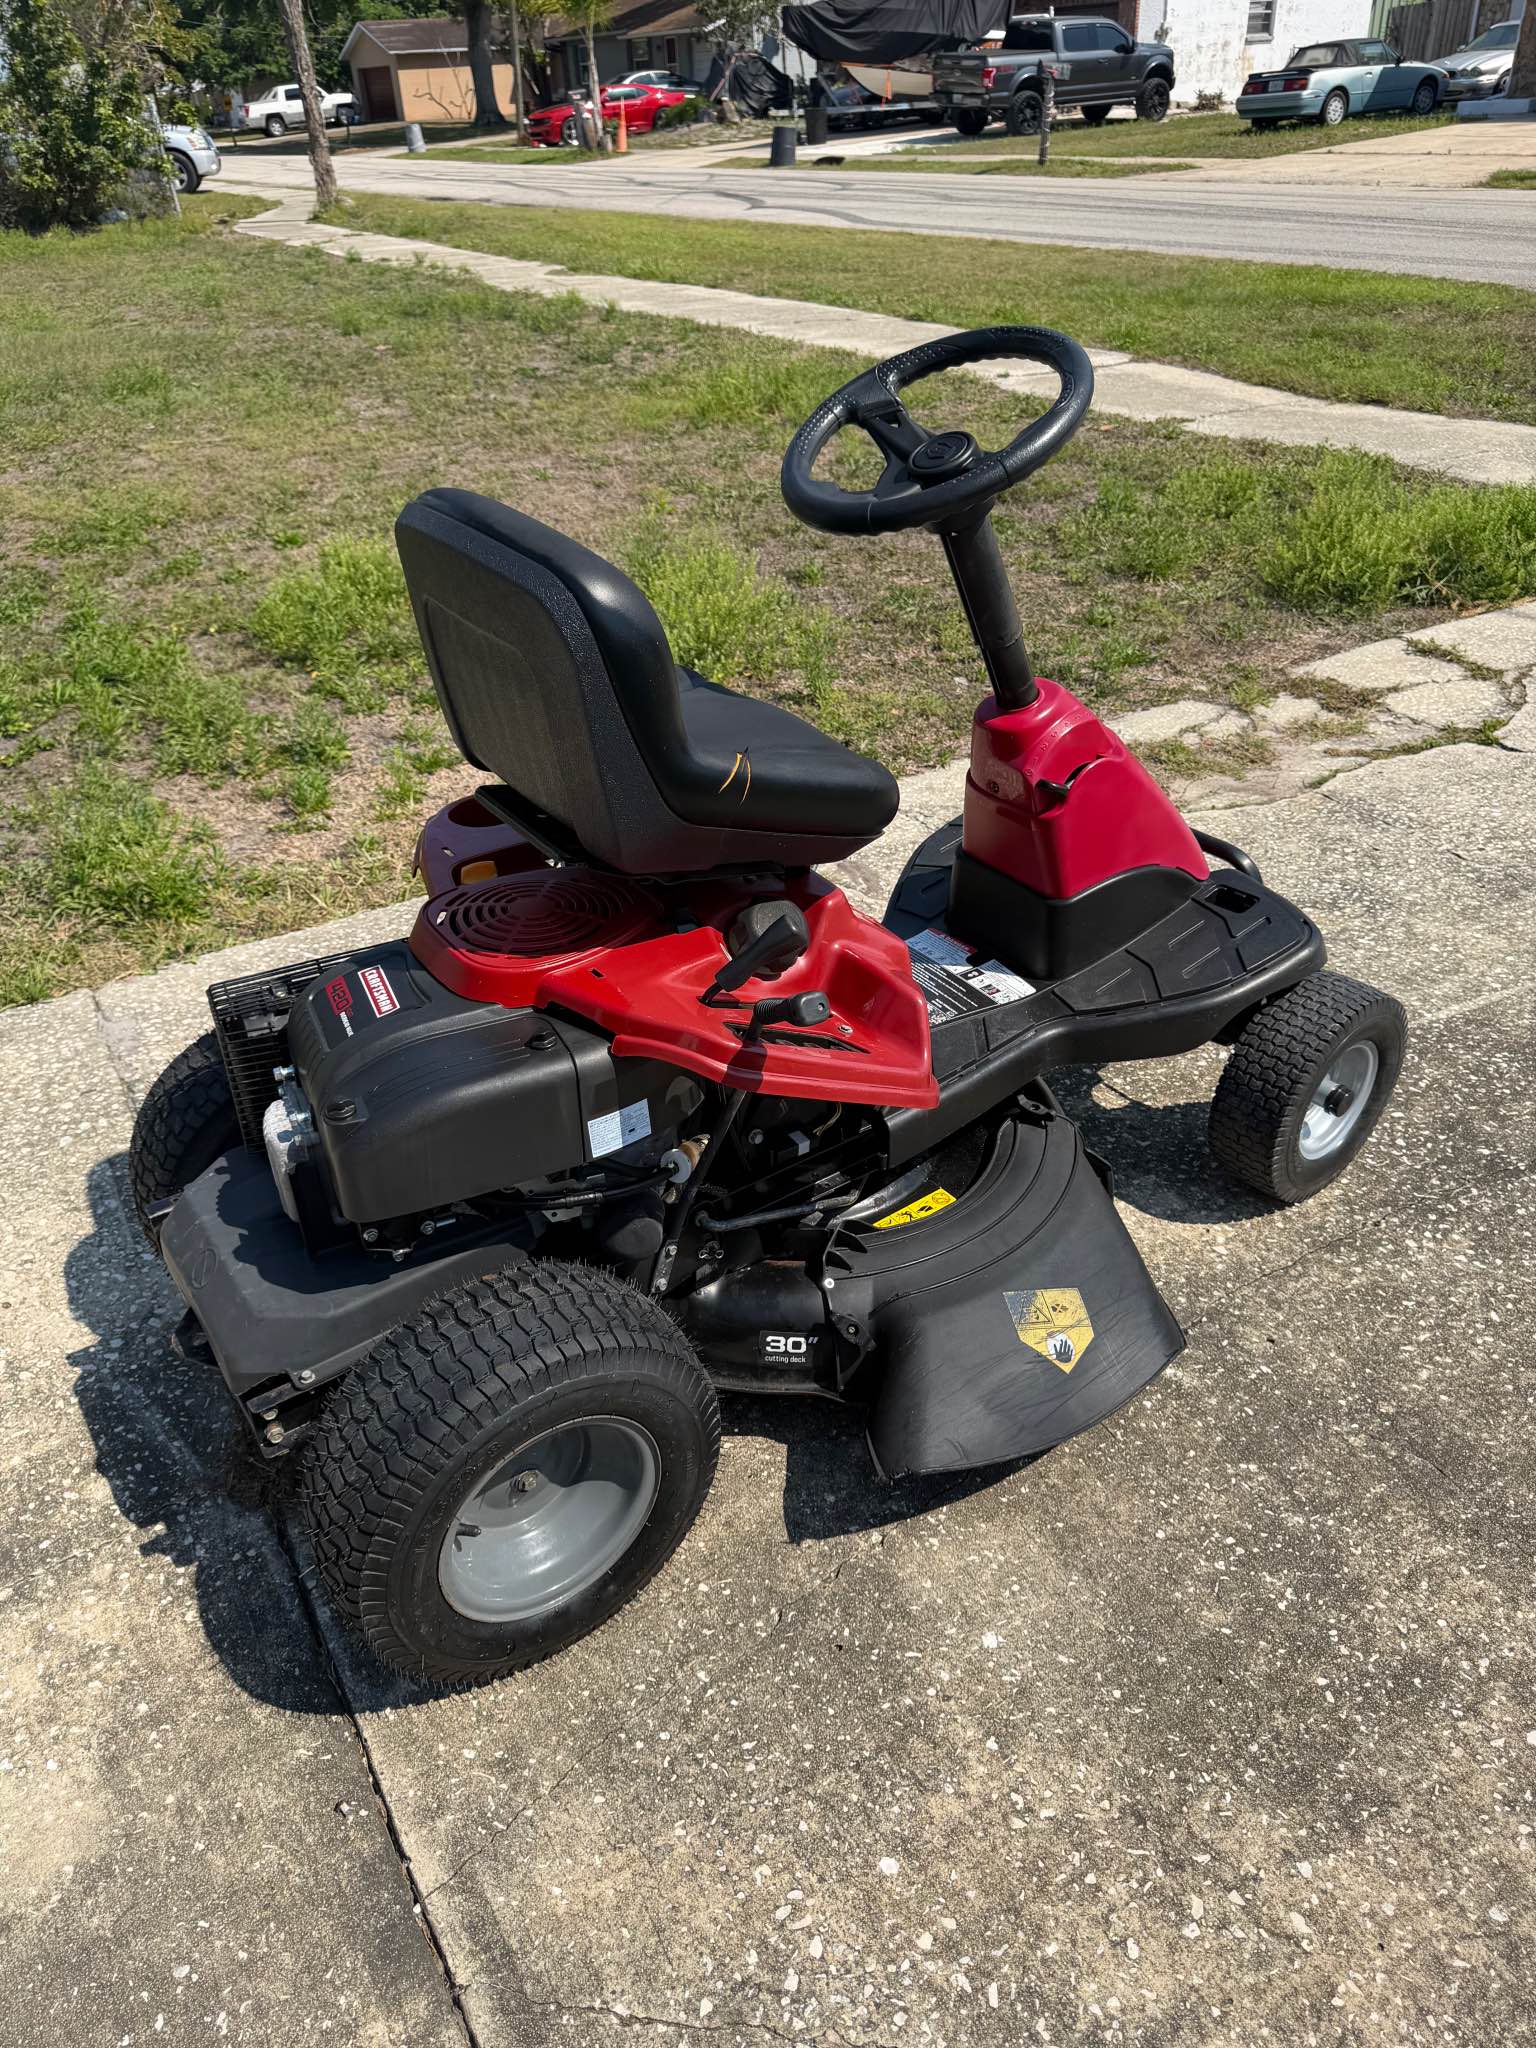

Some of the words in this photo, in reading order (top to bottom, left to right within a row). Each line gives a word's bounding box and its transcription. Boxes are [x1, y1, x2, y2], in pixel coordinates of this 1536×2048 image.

[331, 983, 350, 1011] 420
[364, 969, 394, 1012] CRAFTSMAN
[764, 1355, 789, 1363] cutting
[790, 1355, 806, 1363] deck
